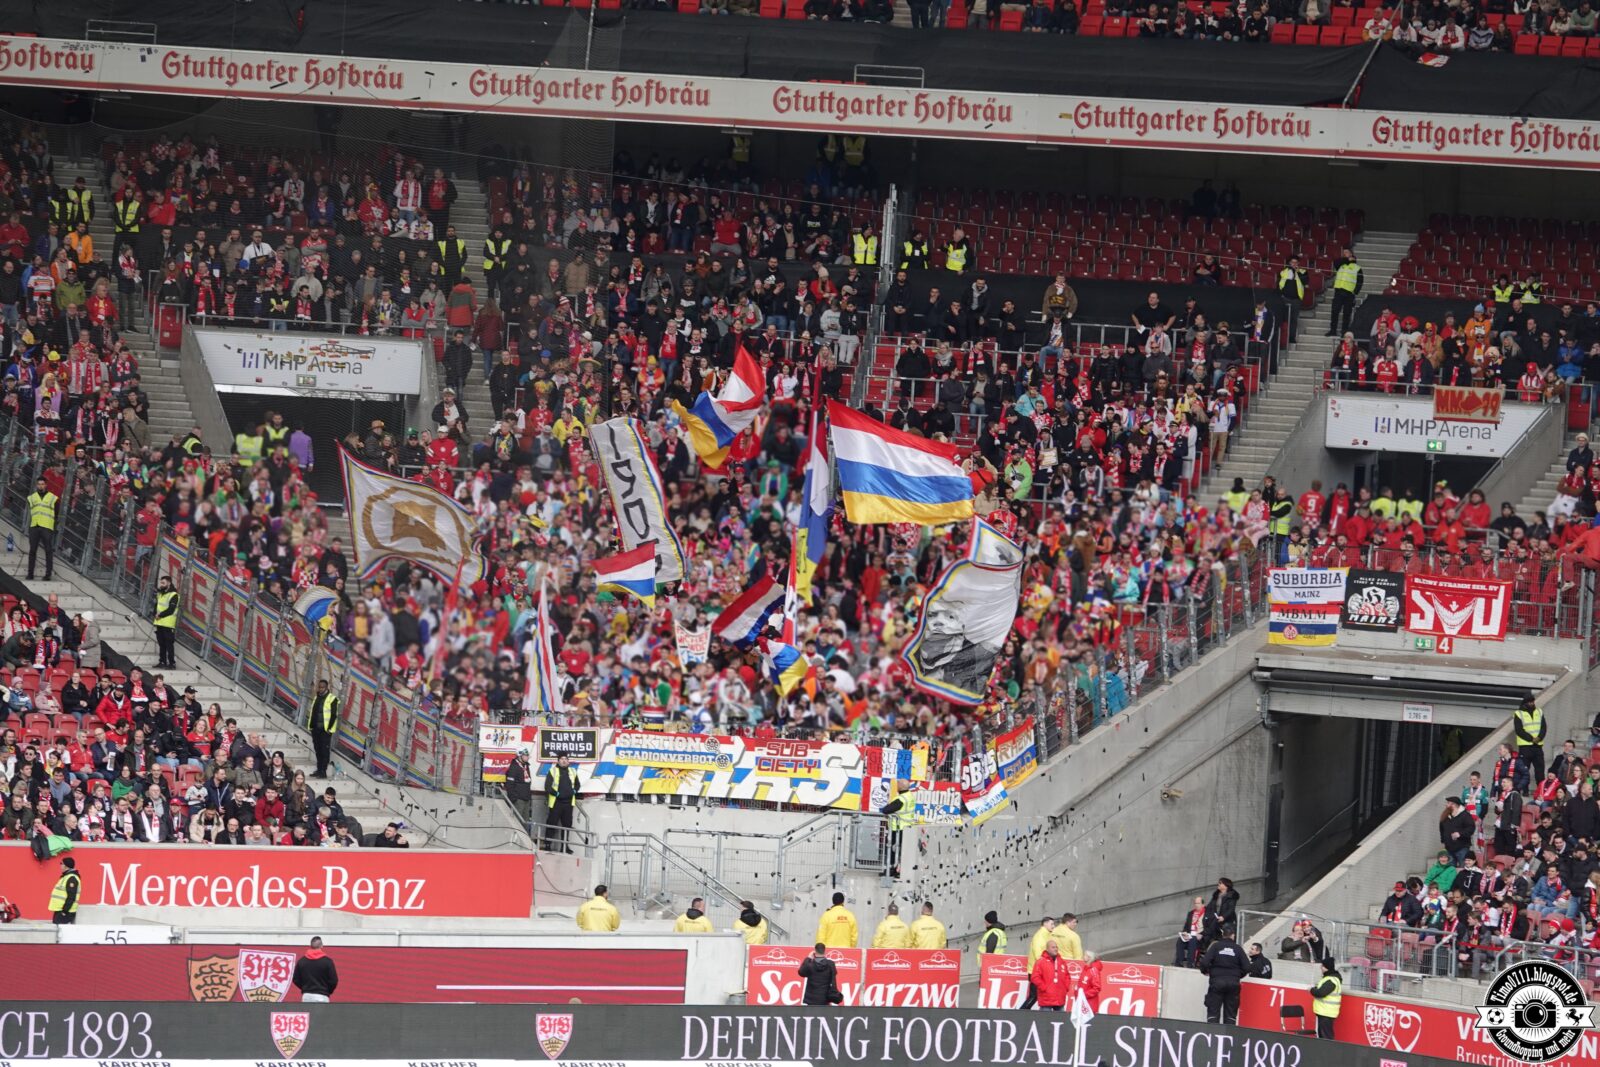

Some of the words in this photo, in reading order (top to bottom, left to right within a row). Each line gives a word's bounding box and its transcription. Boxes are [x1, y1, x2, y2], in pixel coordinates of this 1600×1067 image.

[162, 50, 299, 87] Stuttgarter
[304, 58, 404, 90] Hofbräu
[469, 69, 606, 104] Stuttgarter
[611, 75, 710, 107] Hofbräu
[773, 86, 908, 121] Stuttgarter
[914, 92, 1012, 124] Hofbräu
[1073, 101, 1207, 137] Stuttgarter
[1213, 107, 1311, 138] Hofbräu
[1372, 116, 1505, 151] Stuttgarter
[263, 353, 307, 371] MHP
[309, 355, 362, 375] Arena
[1395, 418, 1436, 436] MHP
[1438, 421, 1491, 440] Arena
[1273, 572, 1342, 585] SUBURBIA
[1294, 591, 1321, 599] MAINZ
[1348, 613, 1397, 624] MAINZ
[1439, 637, 1450, 652] 4
[544, 741, 593, 752] PARADISO
[551, 732, 584, 741] CURVA
[619, 732, 701, 752] SEKTION
[618, 750, 716, 765] STADIONVERBOT
[757, 757, 818, 774] CIETY
[96, 862, 426, 910] Mercedes-Benz
[105, 930, 127, 944] 55
[1270, 987, 1285, 1006] 71
[62, 1011, 163, 1059] 1893.
[682, 1015, 870, 1062] DEFINING
[881, 1017, 1101, 1066] FOOTBALL
[1113, 1025, 1234, 1067] SINCE
[1242, 1038, 1301, 1067] 1893
